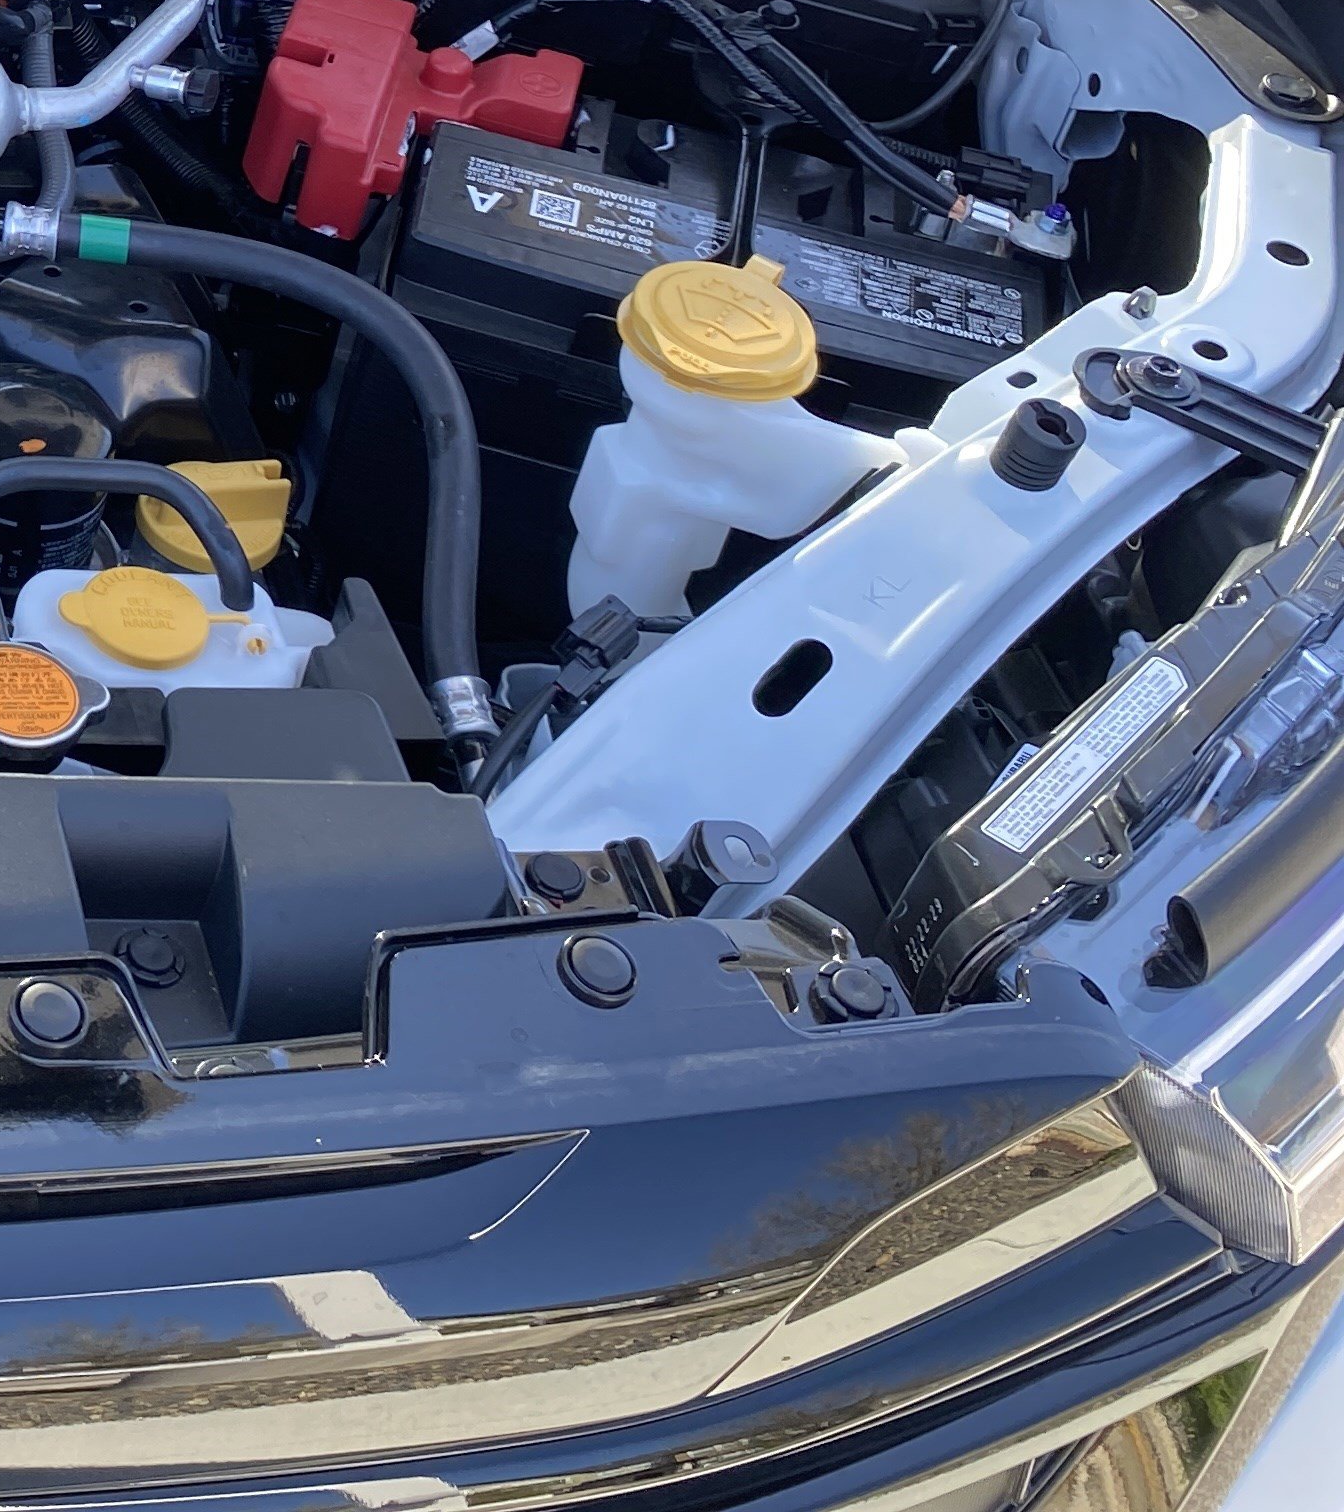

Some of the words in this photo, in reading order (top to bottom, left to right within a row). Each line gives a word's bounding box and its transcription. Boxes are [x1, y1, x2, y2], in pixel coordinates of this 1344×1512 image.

[466, 184, 503, 213] A
[572, 182, 656, 209] 82110AN00B
[627, 215, 653, 228] LN2
[586, 223, 625, 239] AMPS
[622, 242, 651, 254] COLD
[628, 234, 653, 246] 620
[881, 309, 992, 343] DANGER/POISON
